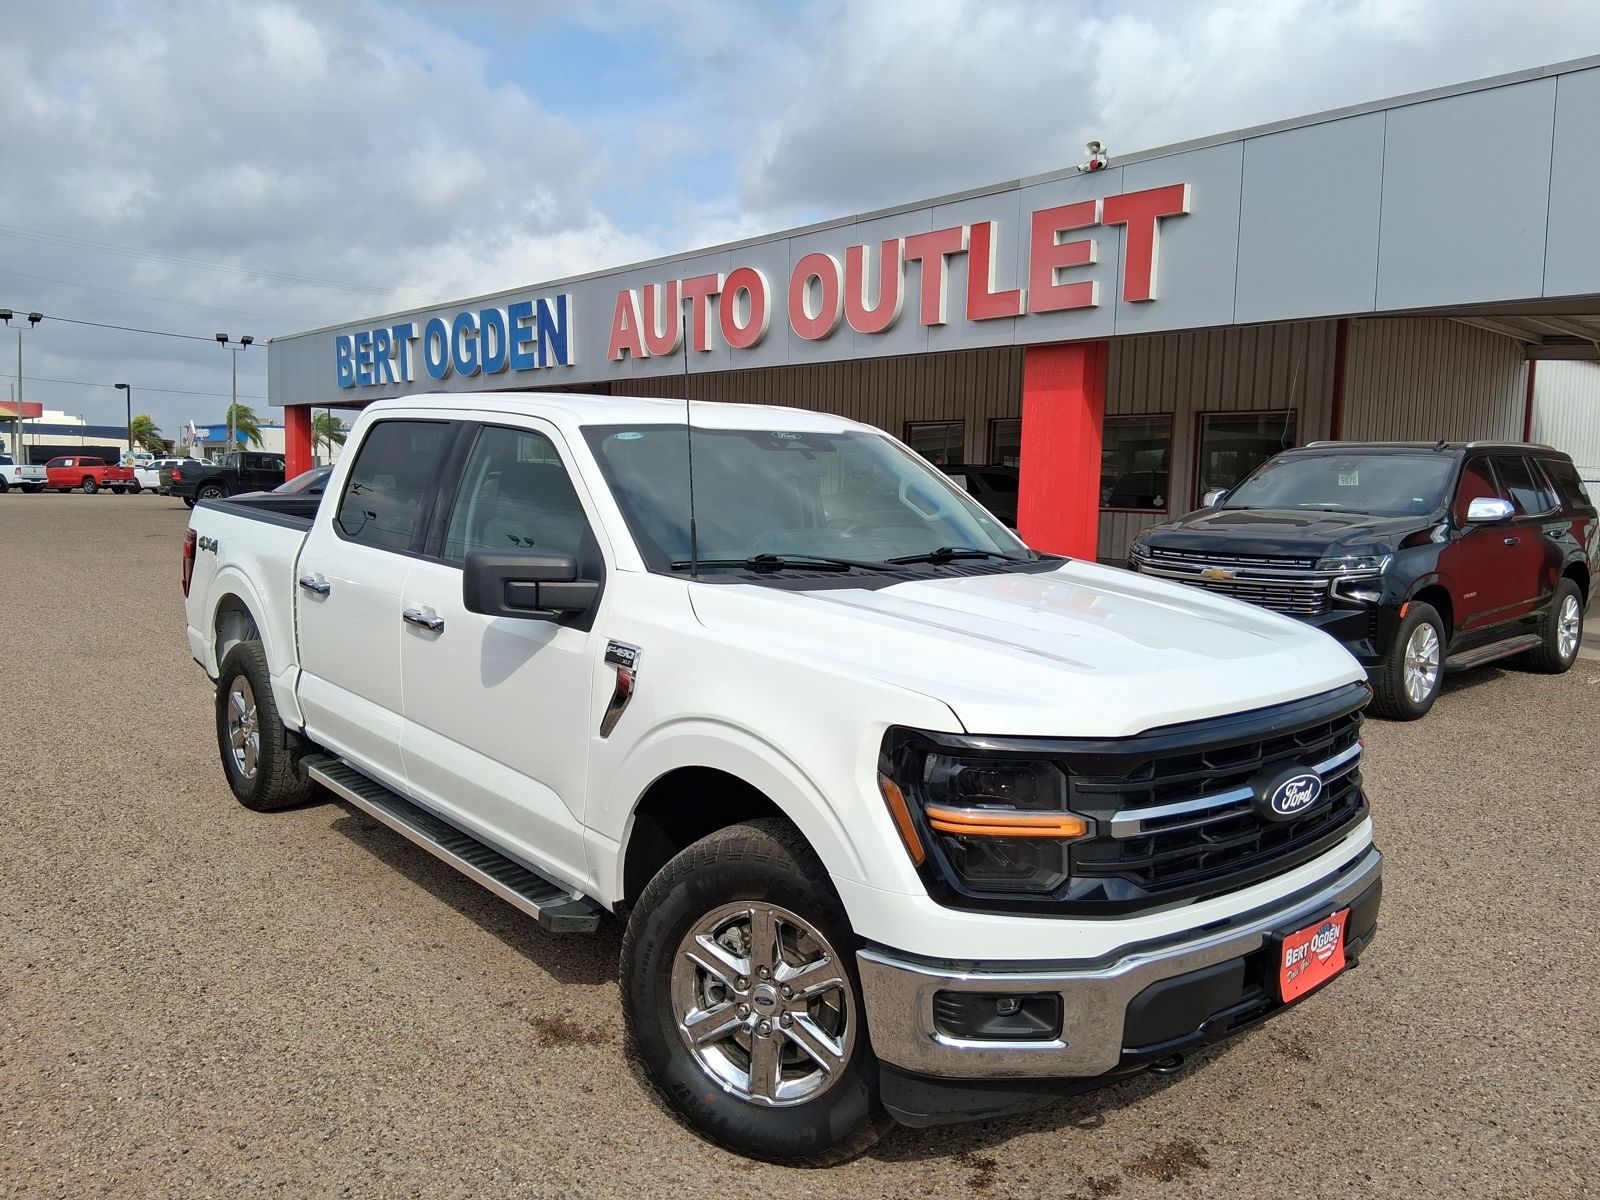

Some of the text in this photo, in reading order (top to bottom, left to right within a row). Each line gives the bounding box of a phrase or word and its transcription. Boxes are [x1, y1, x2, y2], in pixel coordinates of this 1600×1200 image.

[336, 183, 1191, 388] BERT OGDEN AUTO OUTLET
[1281, 780, 1313, 810] Ford
[1285, 923, 1341, 968] BERT OGDEN
